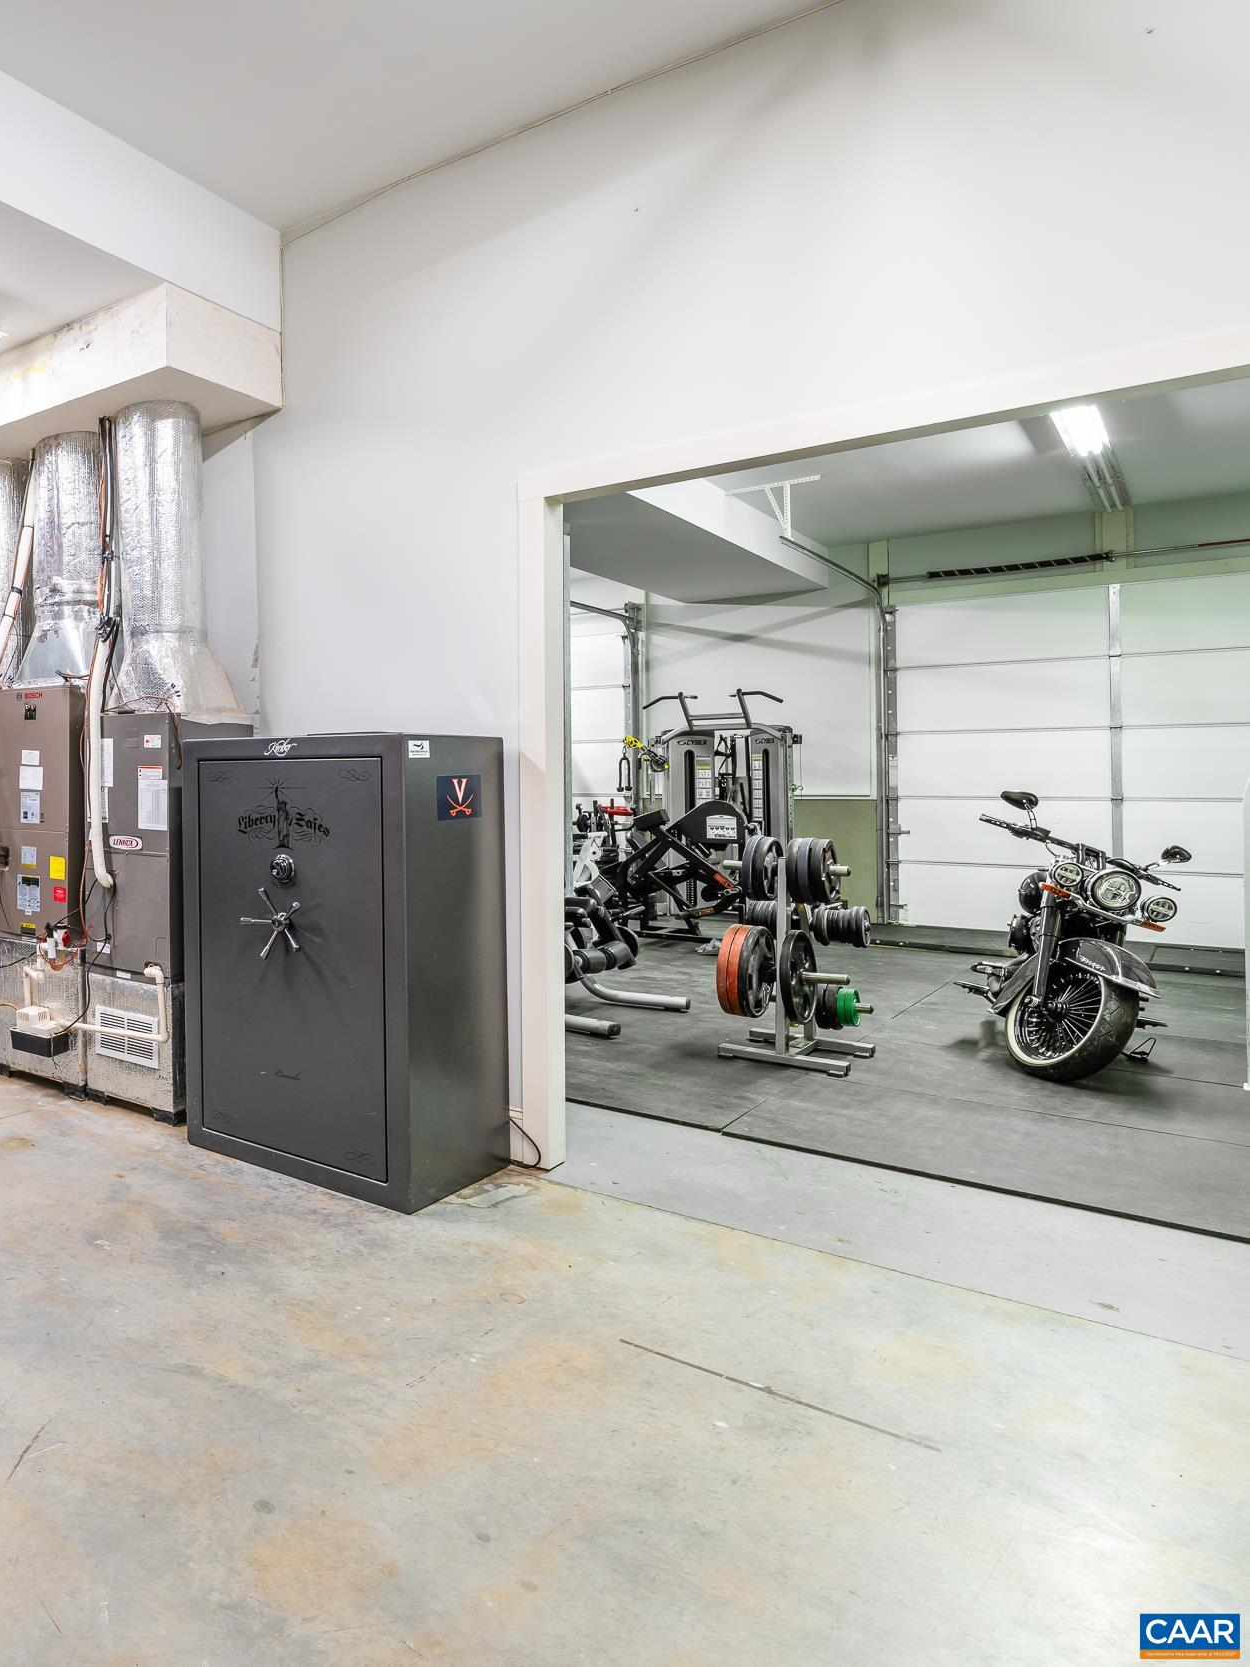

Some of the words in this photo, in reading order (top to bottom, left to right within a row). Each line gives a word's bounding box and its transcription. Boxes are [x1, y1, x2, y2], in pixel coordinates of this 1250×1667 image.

[25, 692, 43, 700] BOSCH
[452, 778, 468, 805] V
[237, 813, 276, 834] Liberty
[294, 812, 330, 837] Safes
[113, 838, 134, 846] LENNOX
